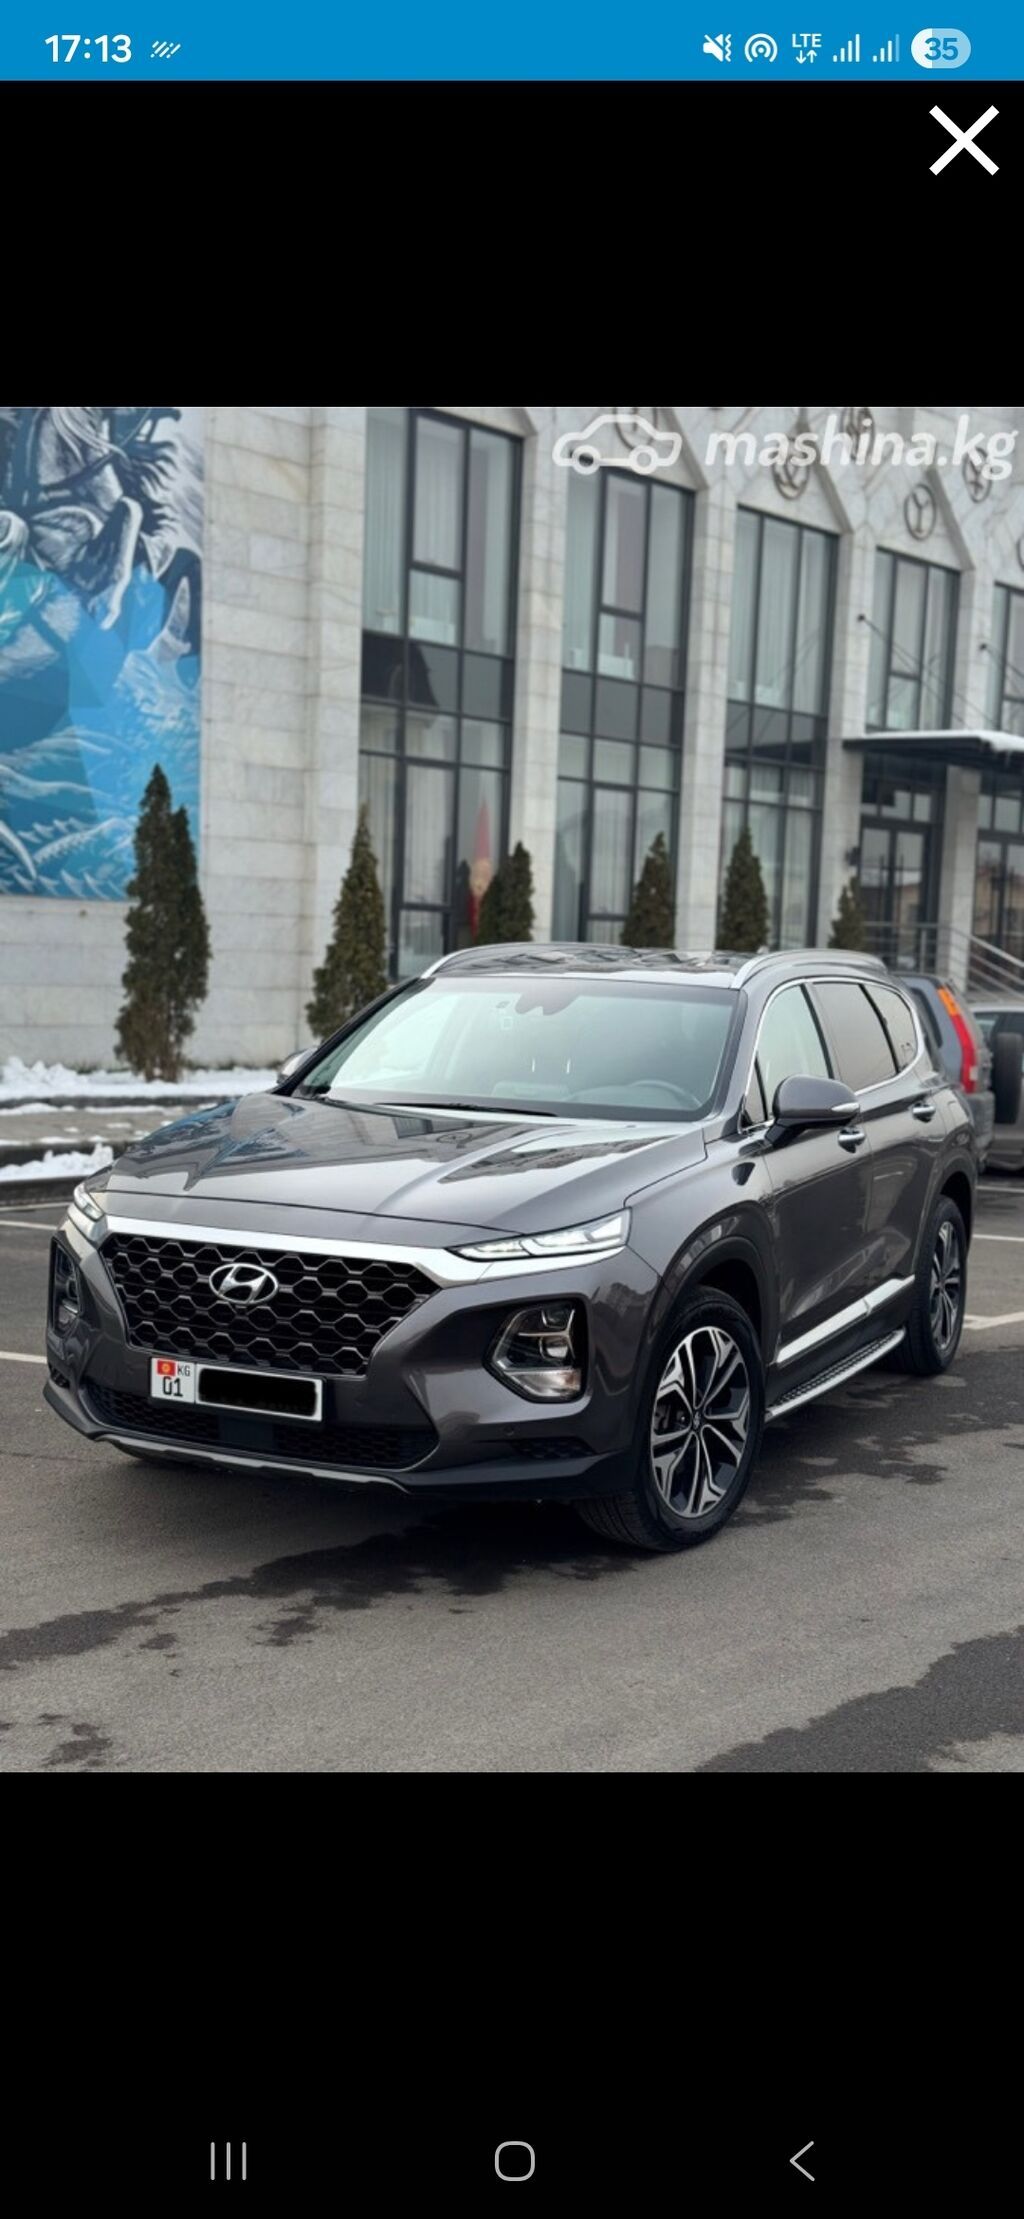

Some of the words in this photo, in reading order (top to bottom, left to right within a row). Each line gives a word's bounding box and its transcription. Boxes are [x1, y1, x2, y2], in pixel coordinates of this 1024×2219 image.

[45, 35, 131, 63] 17:13
[792, 33, 822, 48] LTE
[924, 37, 958, 61] 35
[177, 1365, 191, 1377] KG
[162, 1376, 184, 1398] 01
